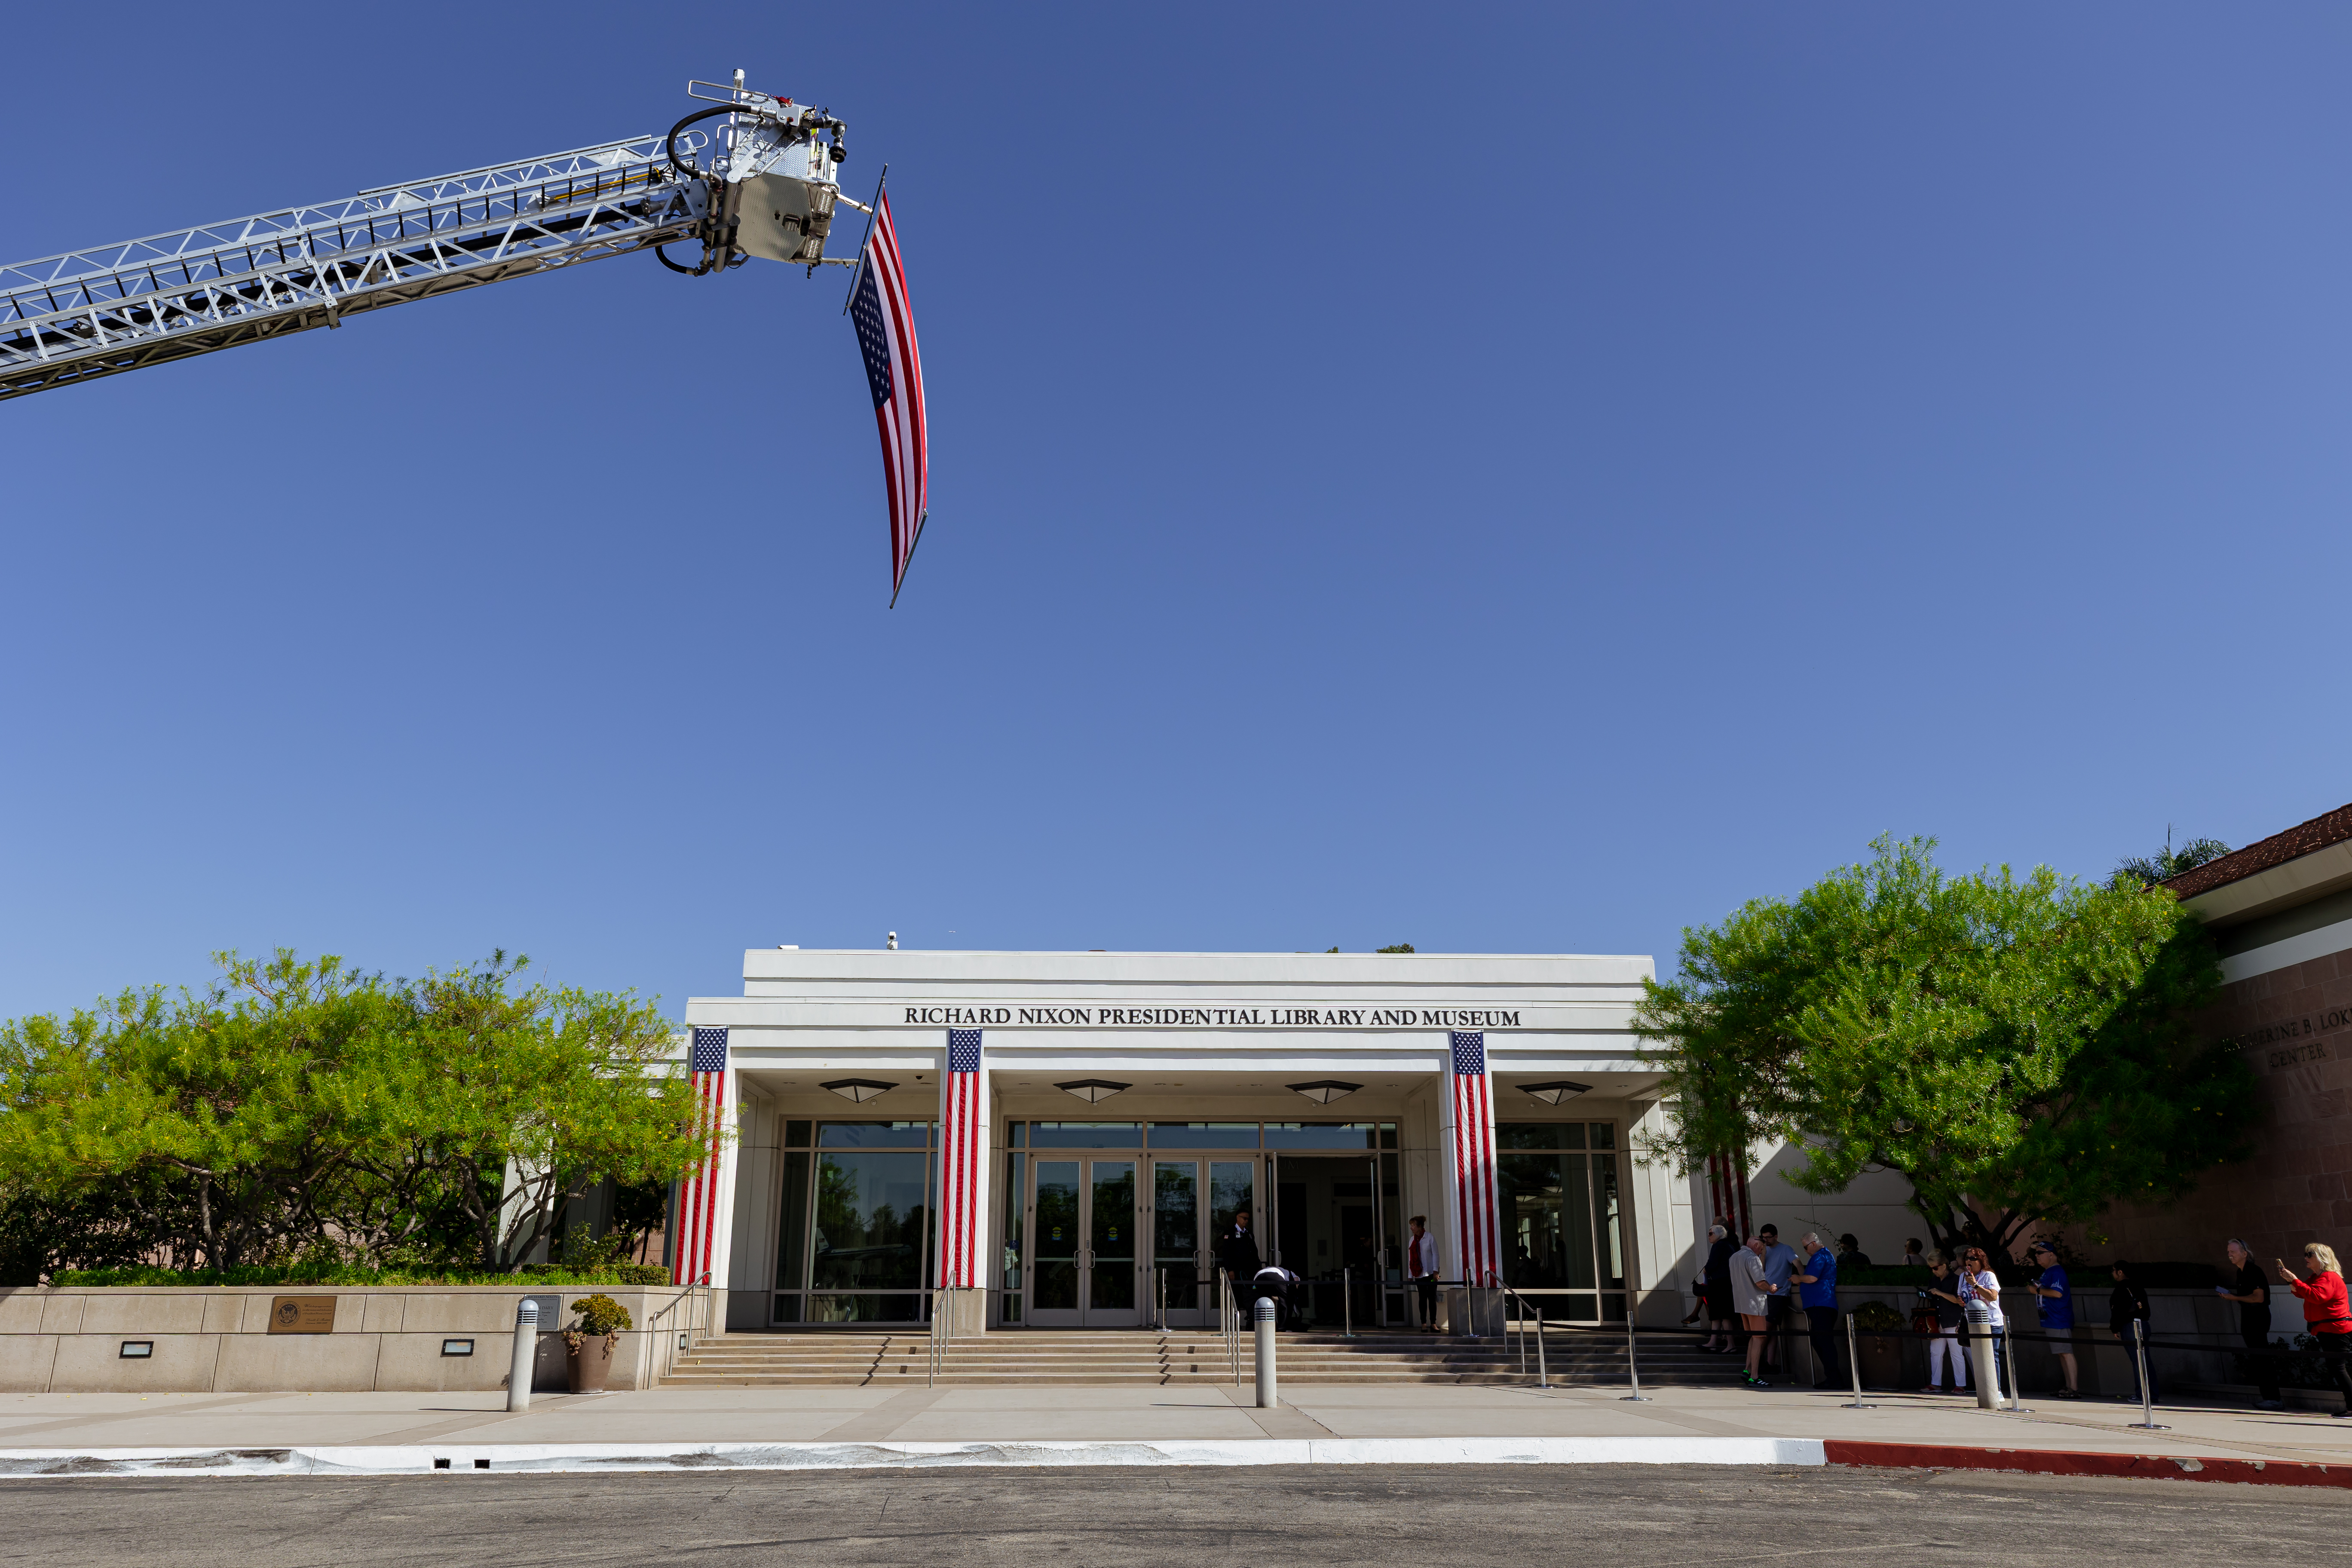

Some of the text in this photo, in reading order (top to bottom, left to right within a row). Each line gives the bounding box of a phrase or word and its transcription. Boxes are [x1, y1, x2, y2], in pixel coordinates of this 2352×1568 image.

[905, 1008, 1521, 1026] RICHARD NIXON PRESIDENTIAL LIBRARY AND MUSEUM
[2303, 1019, 2317, 1034] B.
[2269, 1043, 2327, 1068] CENTER
